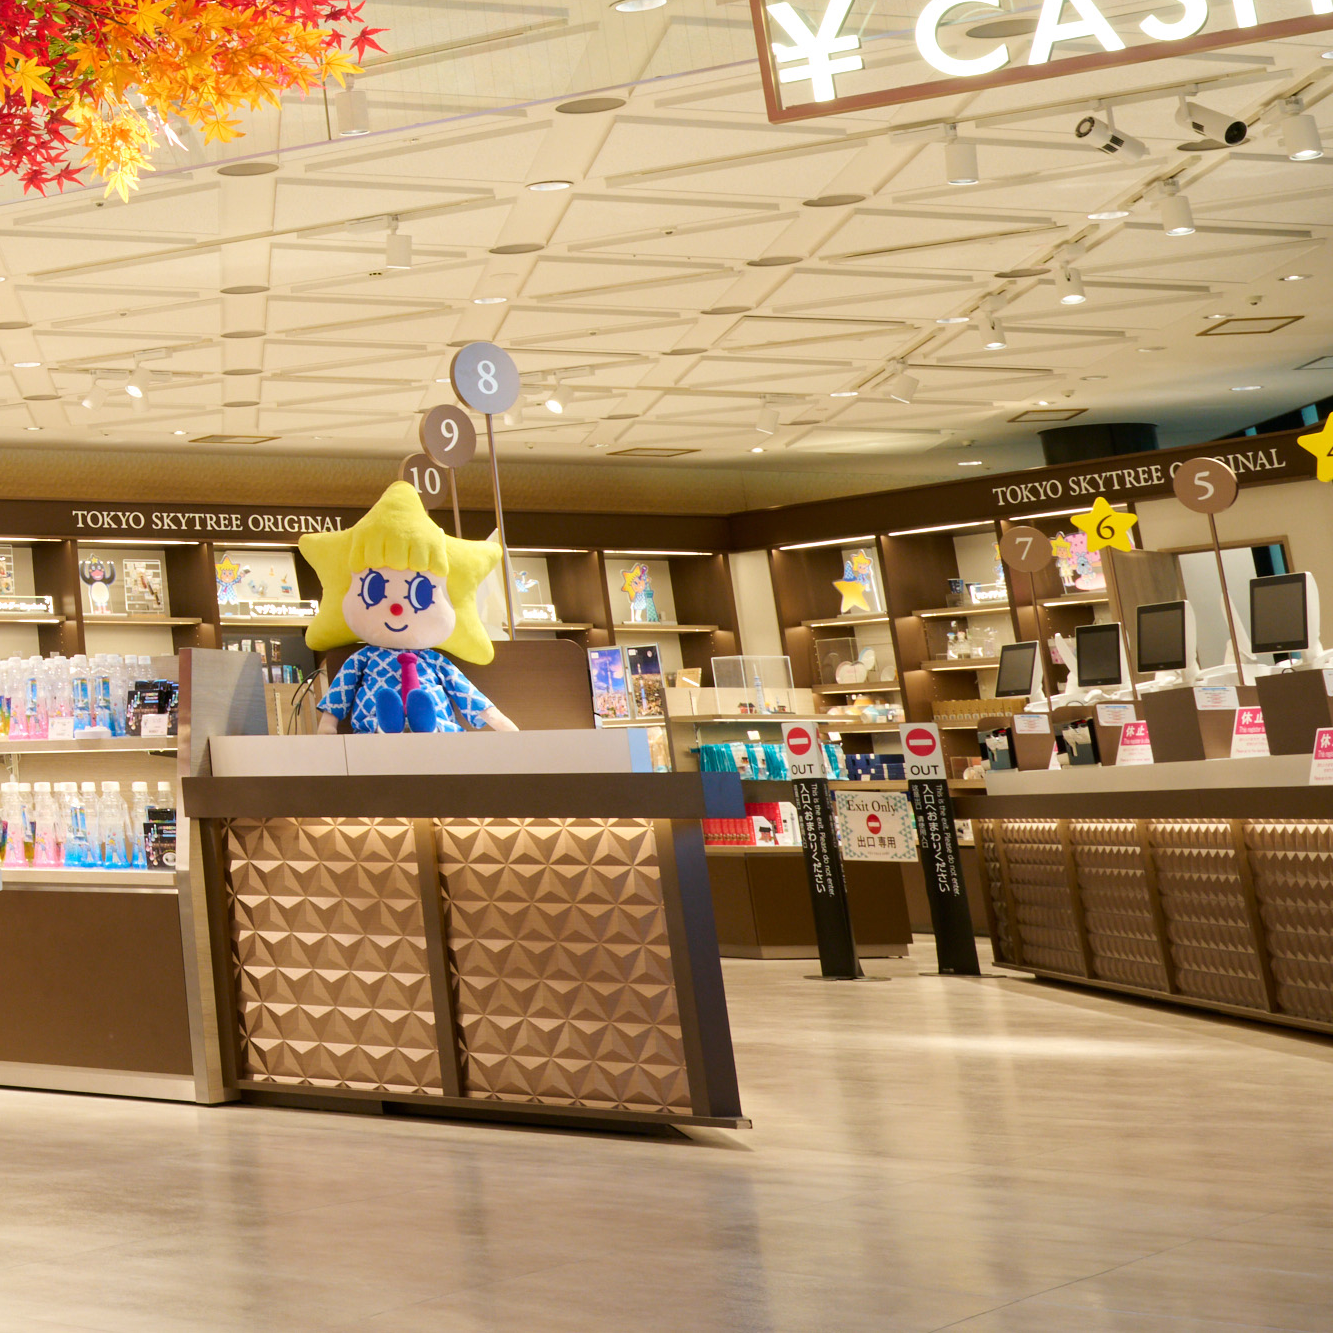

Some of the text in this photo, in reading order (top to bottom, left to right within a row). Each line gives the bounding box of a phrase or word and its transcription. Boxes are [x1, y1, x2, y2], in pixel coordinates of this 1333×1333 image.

[477, 360, 499, 395] 8
[440, 419, 459, 452] 9
[410, 467, 441, 495] 10
[992, 479, 1063, 506] TOKYO
[1069, 465, 1165, 496] SKYTREE
[1193, 471, 1215, 501] 5
[72, 510, 348, 533] TOKYO SKYTREE ORIGINAL
[1096, 514, 1115, 540] 6
[1014, 536, 1033, 561] 7
[1126, 725, 1148, 737] 休止
[791, 764, 814, 775] OUT
[910, 765, 939, 776] OUT
[814, 804, 822, 815] the
[846, 799, 896, 816] Exit Only
[800, 783, 826, 894] 入口へおまわりください
[819, 832, 828, 853] Please
[922, 783, 950, 893] 入口へおまわりください
[944, 832, 953, 854] Please
[823, 854, 830, 864] do
[948, 855, 955, 864] do
[824, 864, 832, 877] not
[949, 865, 957, 877] not
[827, 878, 835, 897] enter.
[951, 878, 960, 896] enter.
